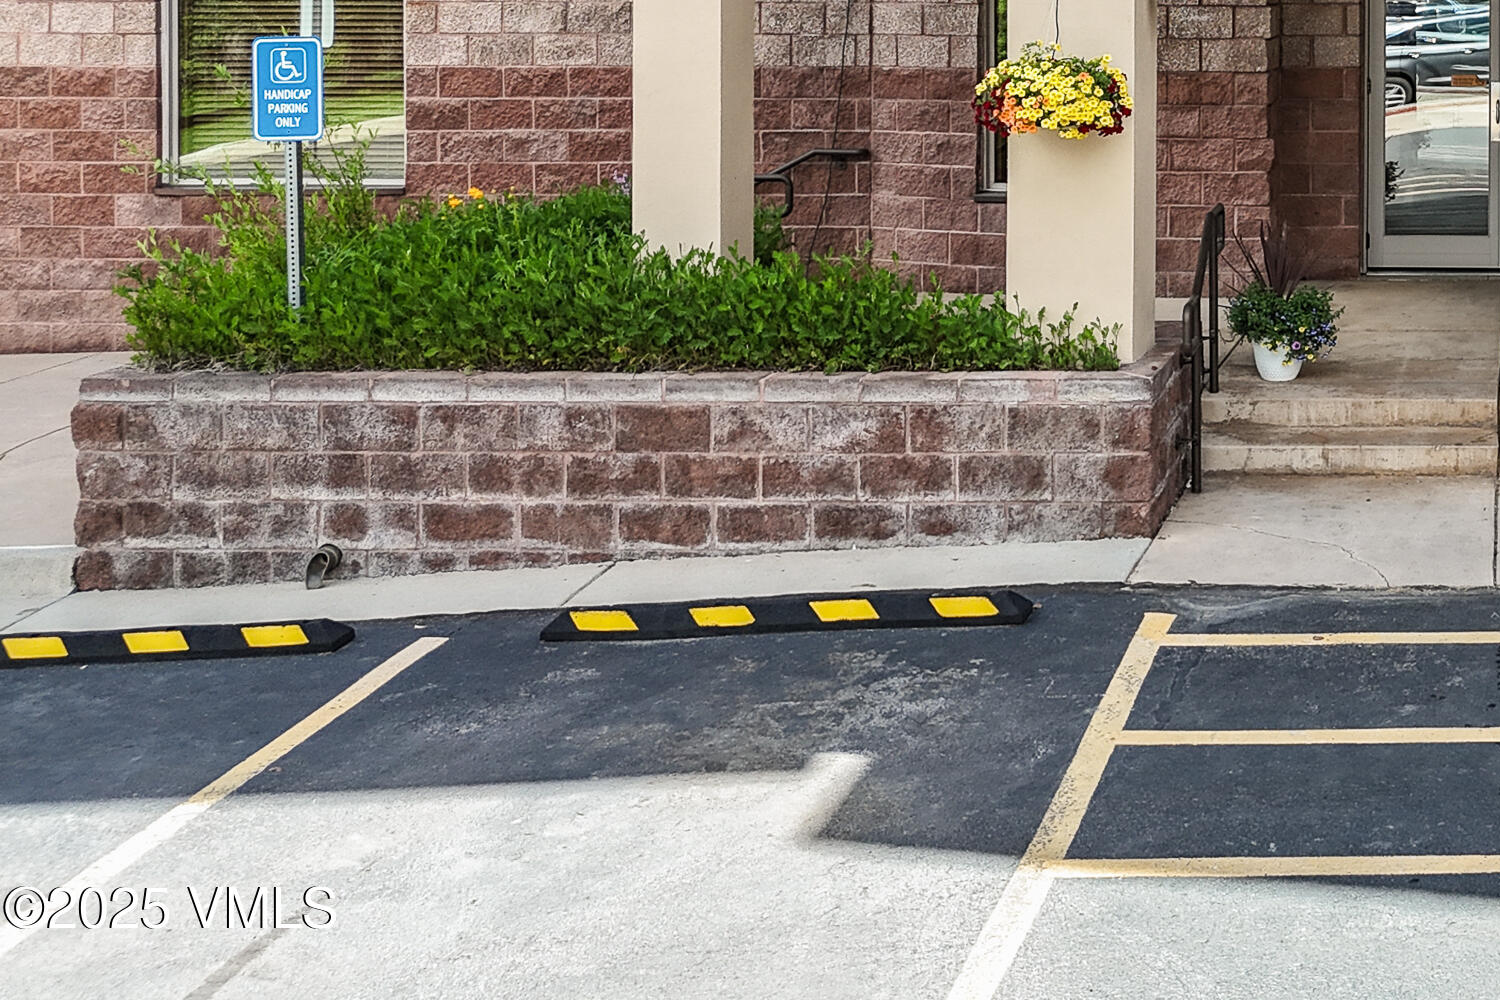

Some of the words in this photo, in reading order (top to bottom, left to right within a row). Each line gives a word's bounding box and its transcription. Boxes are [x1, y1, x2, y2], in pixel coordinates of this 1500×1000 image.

[263, 89, 312, 100] HANDICAP
[267, 103, 308, 114] PARKING
[275, 116, 301, 128] ONLY
